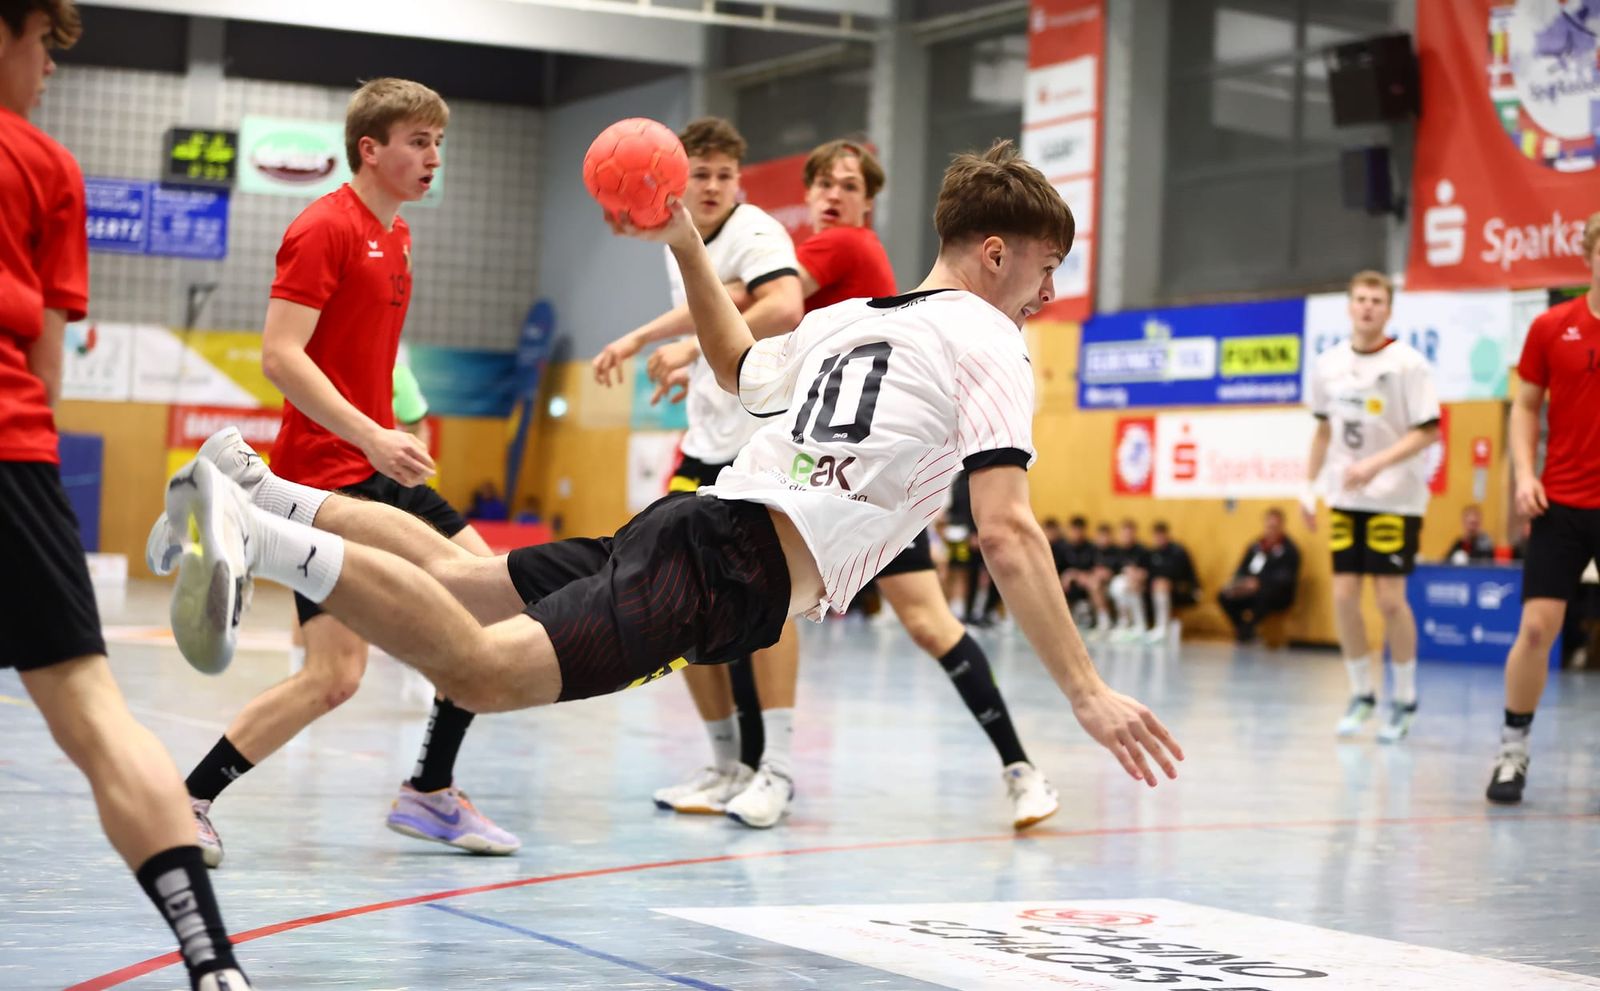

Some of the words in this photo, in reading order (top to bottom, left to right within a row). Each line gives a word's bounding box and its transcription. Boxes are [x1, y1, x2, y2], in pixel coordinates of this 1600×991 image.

[791, 341, 893, 444] 10
[790, 452, 857, 491] eak
[868, 919, 1224, 983] SCHLOSS
[1021, 924, 1329, 979] CASINO
